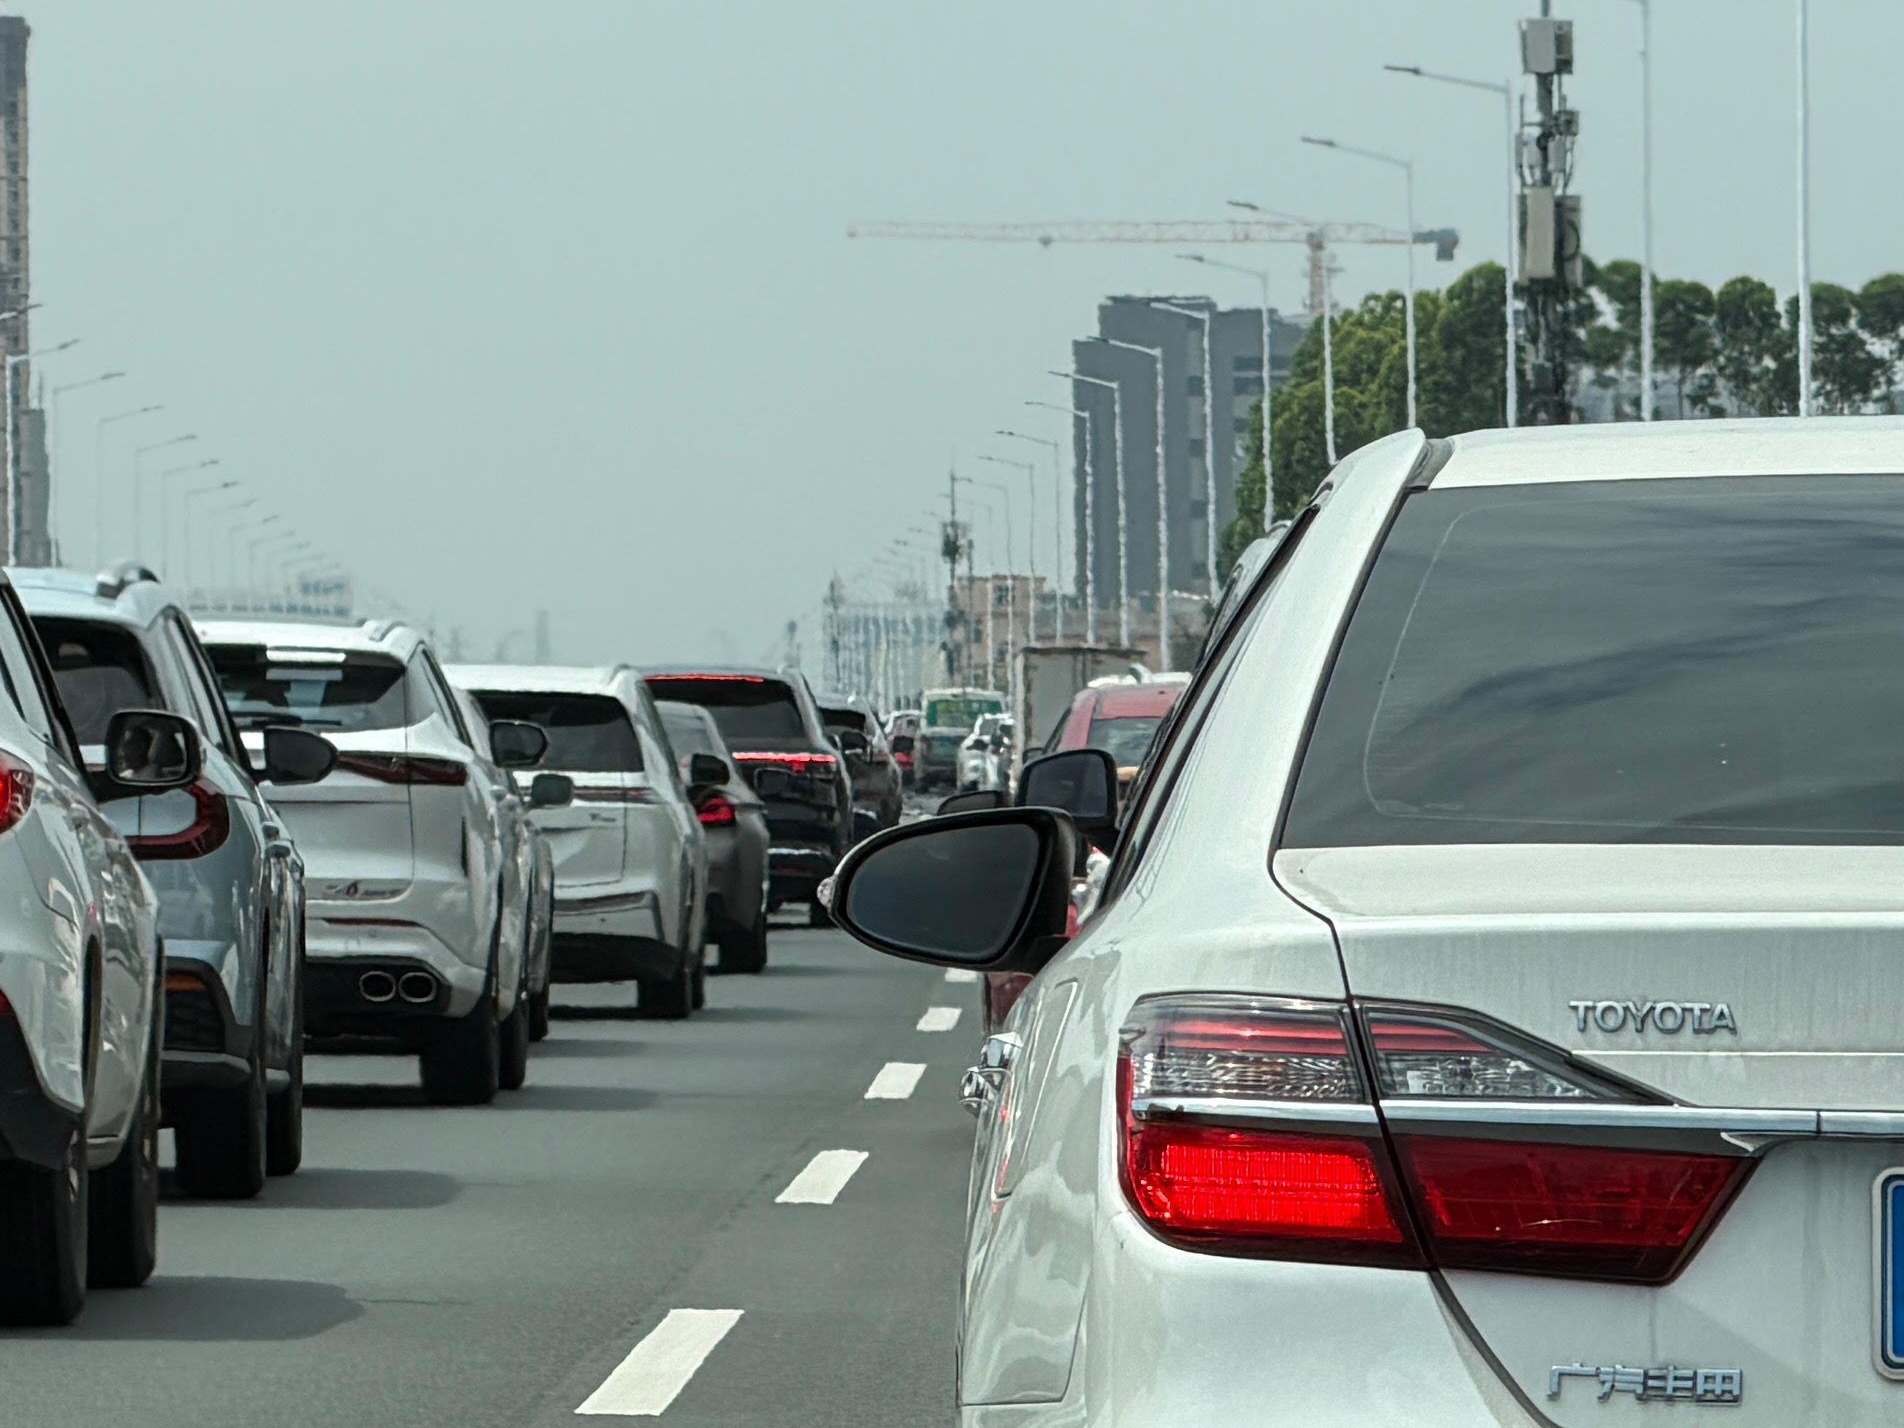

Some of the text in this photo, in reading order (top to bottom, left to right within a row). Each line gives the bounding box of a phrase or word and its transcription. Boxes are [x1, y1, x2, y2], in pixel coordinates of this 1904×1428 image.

[1569, 1000, 1737, 1035] TOYOTA
[1547, 1362, 1743, 1406] 广汽丰田
